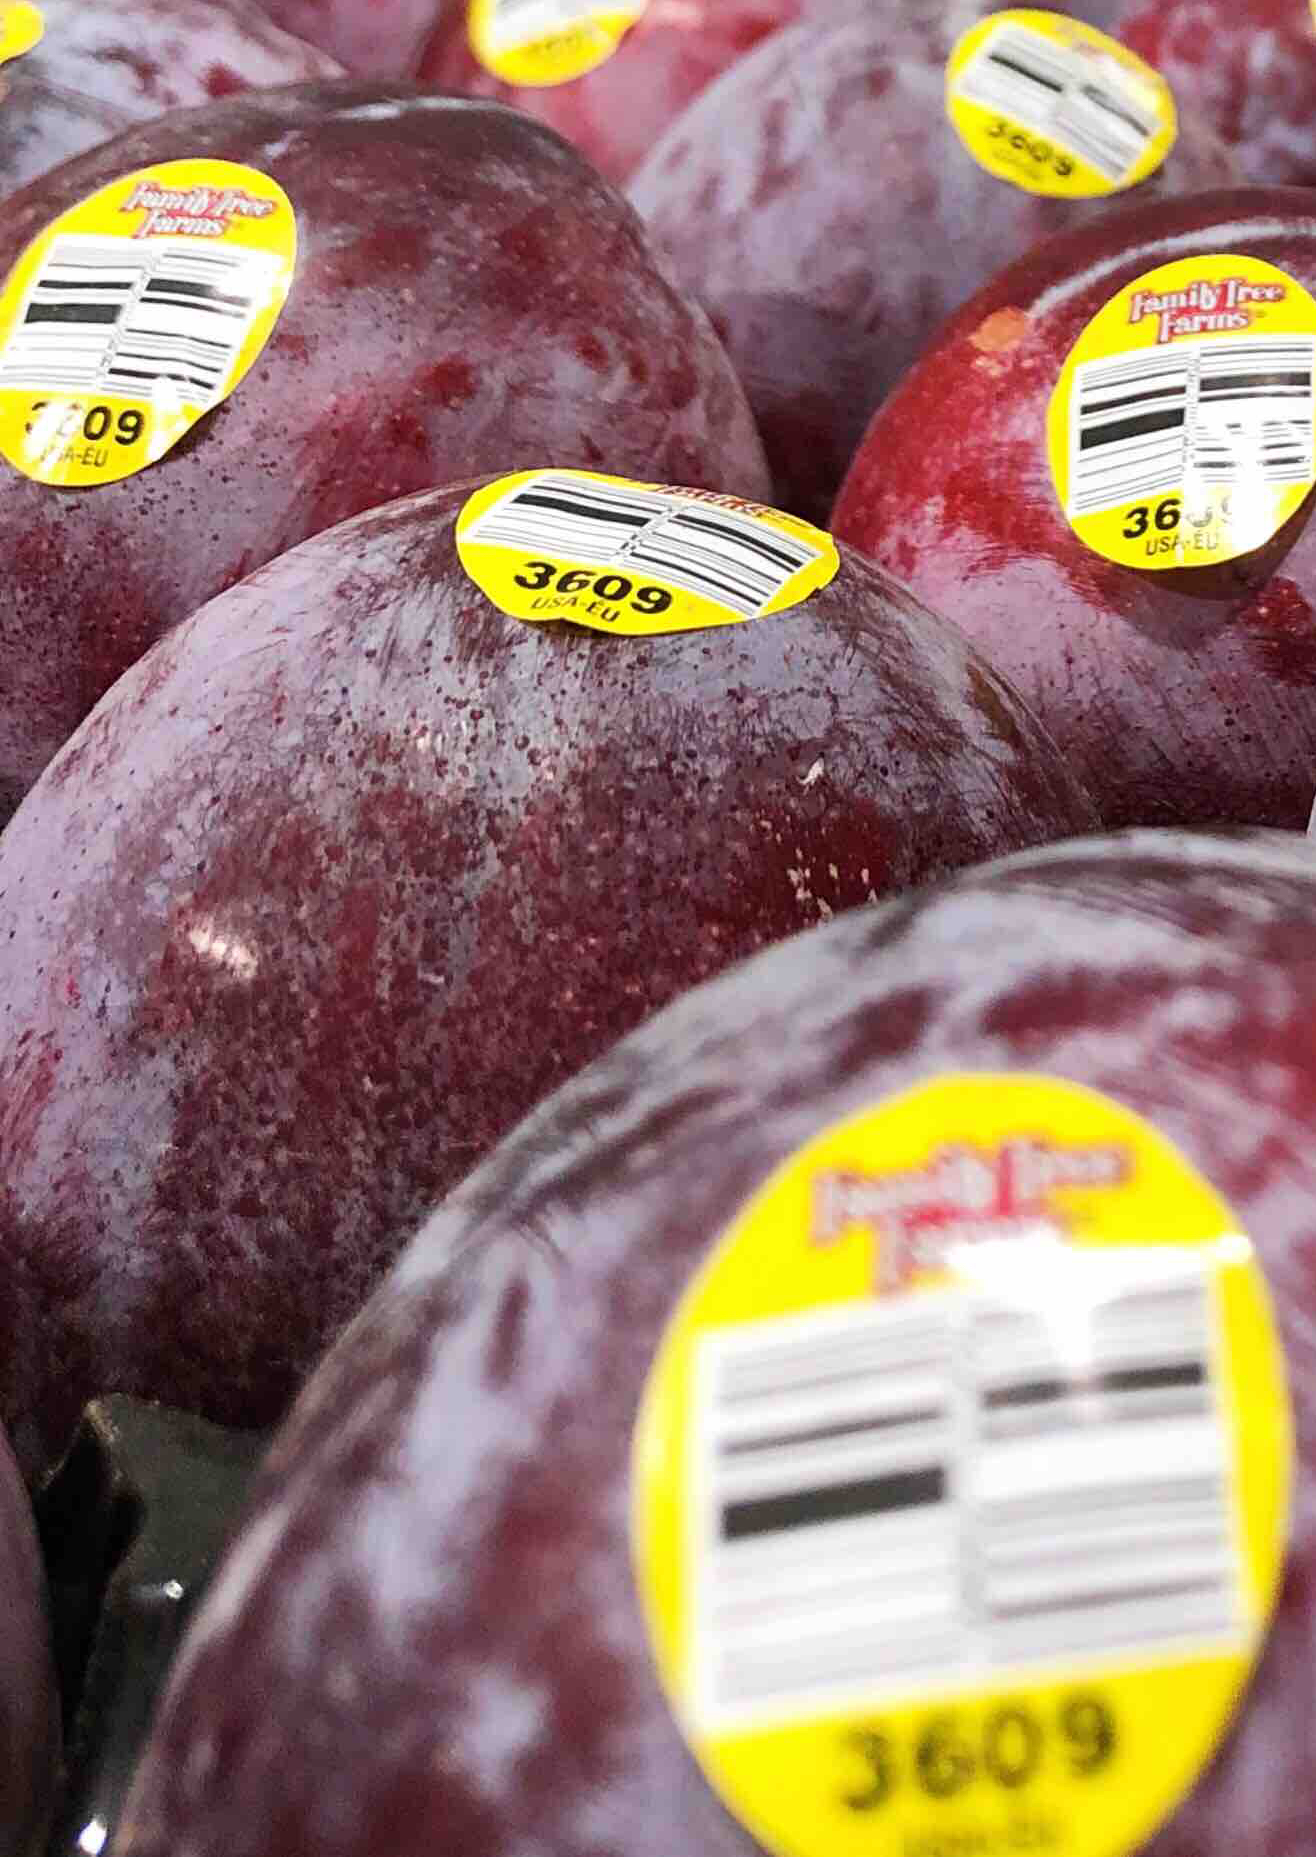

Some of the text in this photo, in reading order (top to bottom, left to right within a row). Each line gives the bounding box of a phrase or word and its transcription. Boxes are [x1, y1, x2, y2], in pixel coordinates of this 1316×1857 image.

[1130, 278, 1286, 324] Family Tree
[1156, 311, 1252, 345] Farms
[24, 401, 145, 446] 09
[513, 561, 673, 614] 3609
[529, 596, 621, 623] USA-EU
[838, 1693, 1120, 1815] 3609
